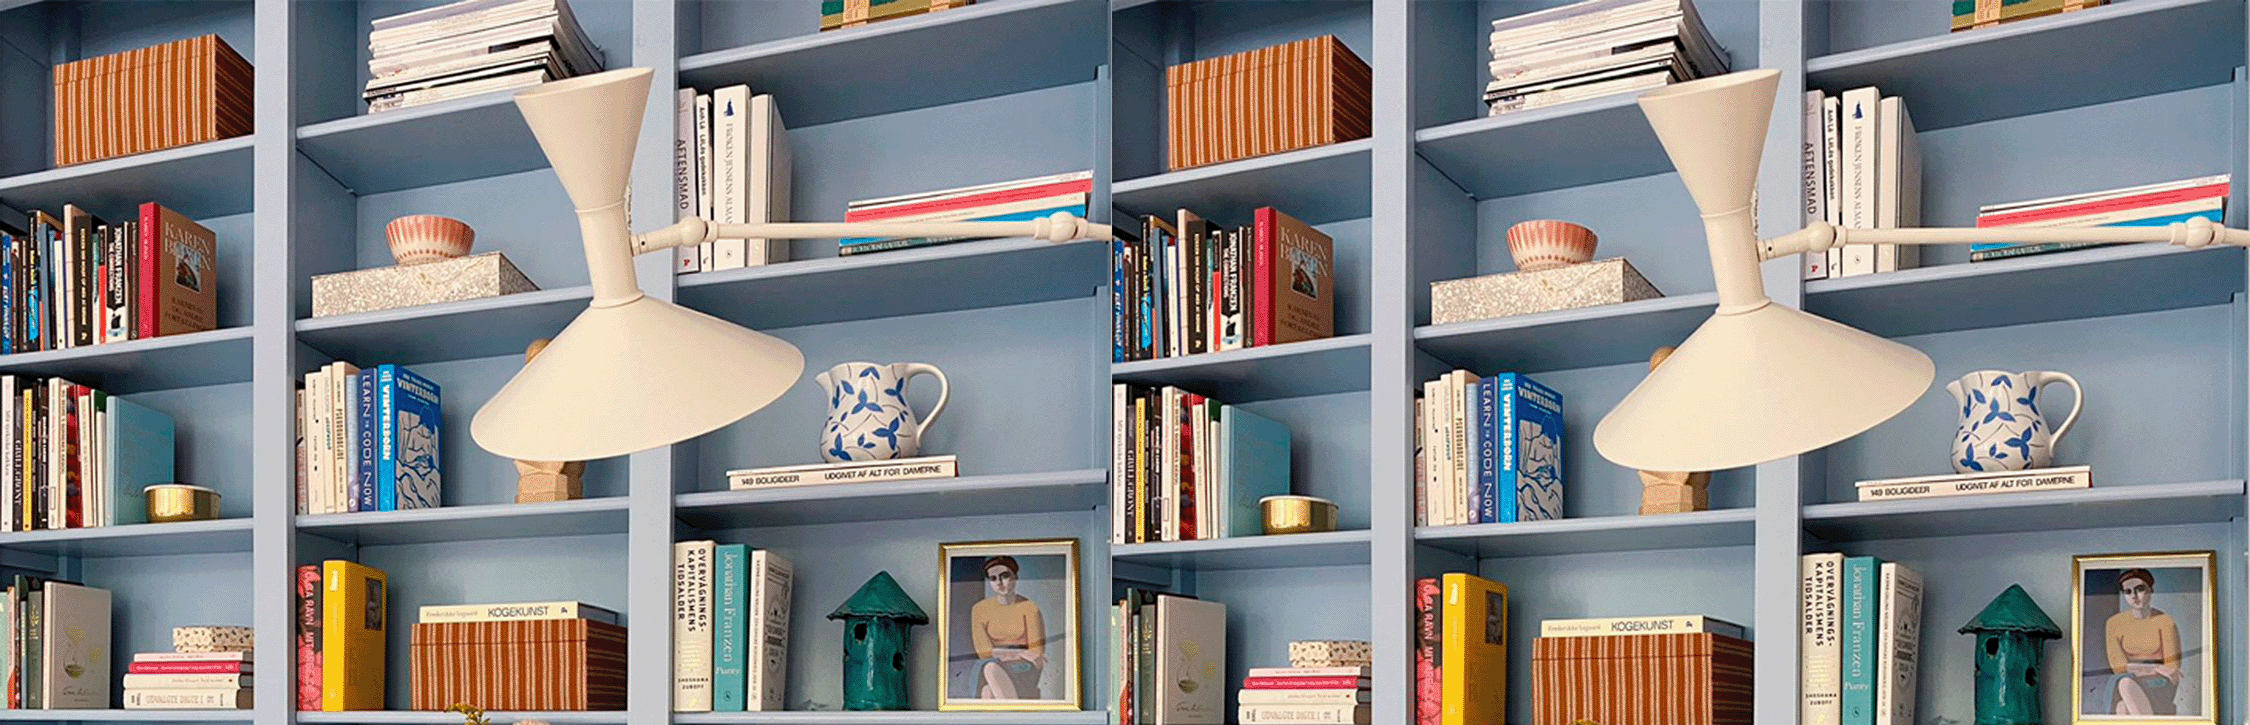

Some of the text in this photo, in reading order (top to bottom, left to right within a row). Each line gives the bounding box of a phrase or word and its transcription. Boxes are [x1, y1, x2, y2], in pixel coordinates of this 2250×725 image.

[677, 139, 689, 210] AFTENSMAD
[724, 159, 734, 195] JENSENS
[1805, 142, 1817, 215] AFTENSMAD
[1853, 163, 1863, 199] JENSENS
[165, 222, 210, 255] KAREN
[1281, 227, 1327, 261] KAREN
[114, 227, 123, 305] JONATHAN FRANZEN
[1229, 232, 1238, 312] JONATHAN FRANZEN
[362, 374, 371, 417] LEARN
[1482, 383, 1492, 427] LEARN
[335, 408, 344, 460] PSEUDOARBEJDE
[382, 385, 392, 460] VINTERBORN
[1503, 394, 1513, 471] VINTERBORN
[362, 431, 371, 466] CODE
[1455, 417, 1464, 471] PSEUDOARBEJDE
[1482, 441, 1492, 477] CODE
[363, 472, 373, 506] NOW
[741, 475, 800, 486] 149 BOLIGIDEER
[824, 465, 942, 480] UDGIVET AF ALT FOR DAMERNE
[1955, 476, 2076, 491] UDGIVET AF ALT FOR DAMERNE
[1483, 483, 1494, 518] NOW
[1870, 486, 1930, 497] 149 BOLIGIDEER
[688, 550, 696, 632] KAPITALISMENS
[698, 548, 708, 632] OVERVÅGNINGS-
[724, 551, 738, 663] Jonathan Franzen
[1816, 563, 1824, 646] KAPITALISMENS
[1826, 561, 1836, 646] OVERVÅGNINGS-
[305, 599, 314, 625] RAVN
[488, 606, 549, 618] KOGEKUNST
[1424, 613, 1433, 639] RAVN
[1611, 620, 1674, 632] KOGEKUNST
[1853, 564, 1867, 678] Jonathan Franzen
[305, 631, 314, 648] MIT
[1424, 645, 1433, 663] MIT
